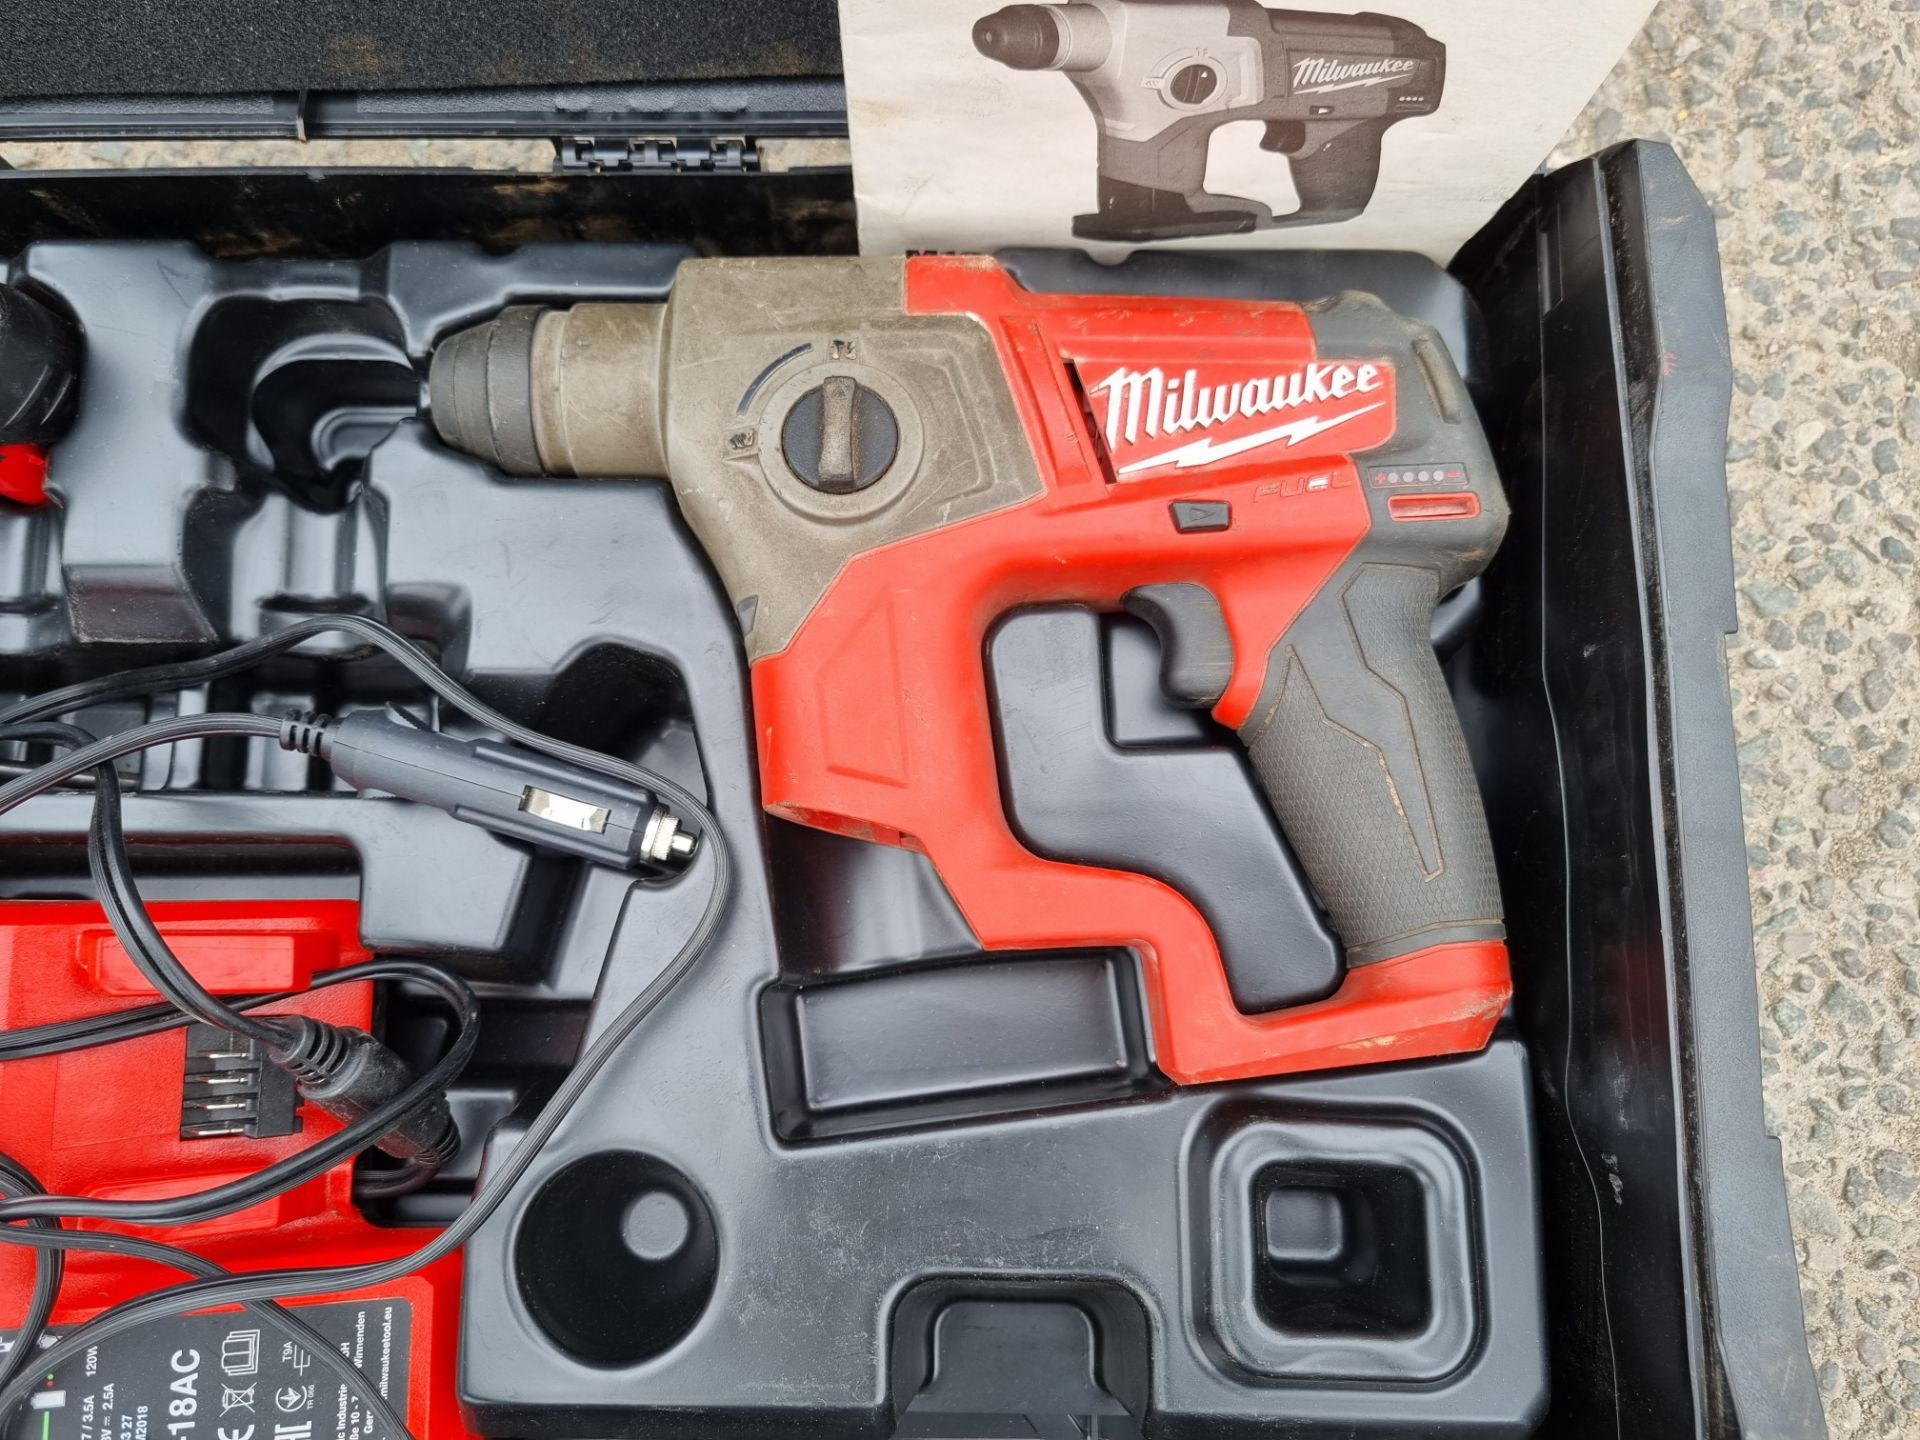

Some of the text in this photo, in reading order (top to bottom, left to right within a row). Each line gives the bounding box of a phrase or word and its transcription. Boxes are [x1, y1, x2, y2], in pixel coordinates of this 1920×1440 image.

[1292, 57, 1414, 88] Milwaukee
[1089, 362, 1383, 453] Milwaukee
[82, 1394, 95, 1422] 3.5A
[102, 1383, 115, 1410] 2.5A
[121, 1415, 133, 1429] 27
[350, 1412, 360, 1425] 10
[363, 1409, 374, 1434] Ger
